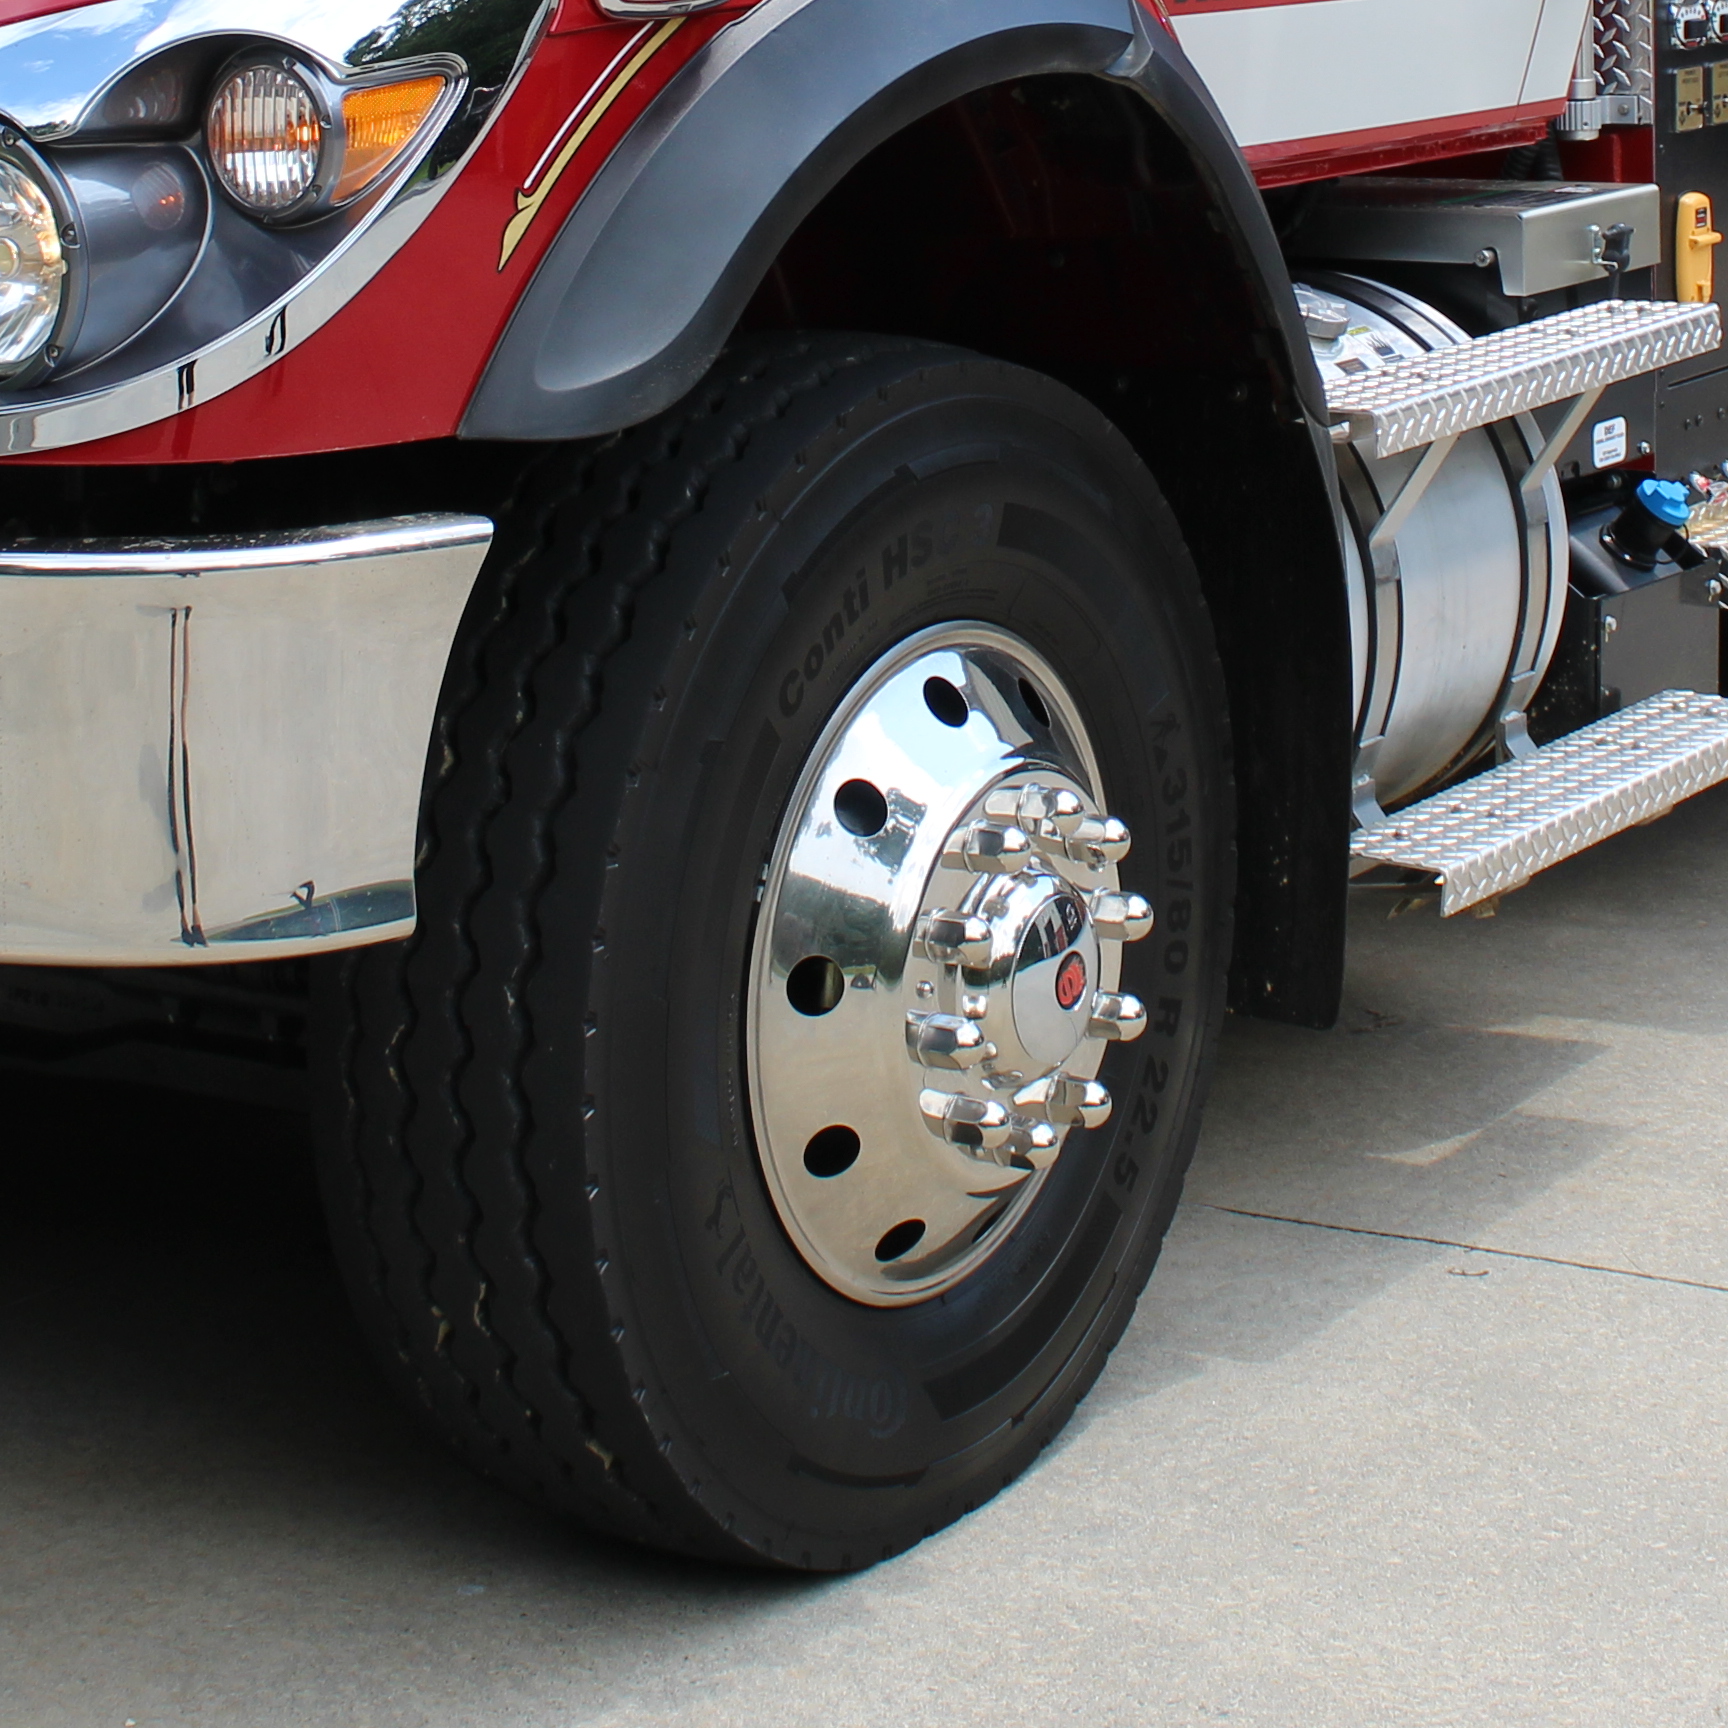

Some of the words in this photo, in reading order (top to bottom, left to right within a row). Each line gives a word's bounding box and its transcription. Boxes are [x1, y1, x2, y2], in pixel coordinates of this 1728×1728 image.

[778, 567, 871, 719] Conti
[1162, 767, 1194, 975] 315/80
[1153, 996, 1184, 1039] R
[1110, 1060, 1169, 1195] 22.5
